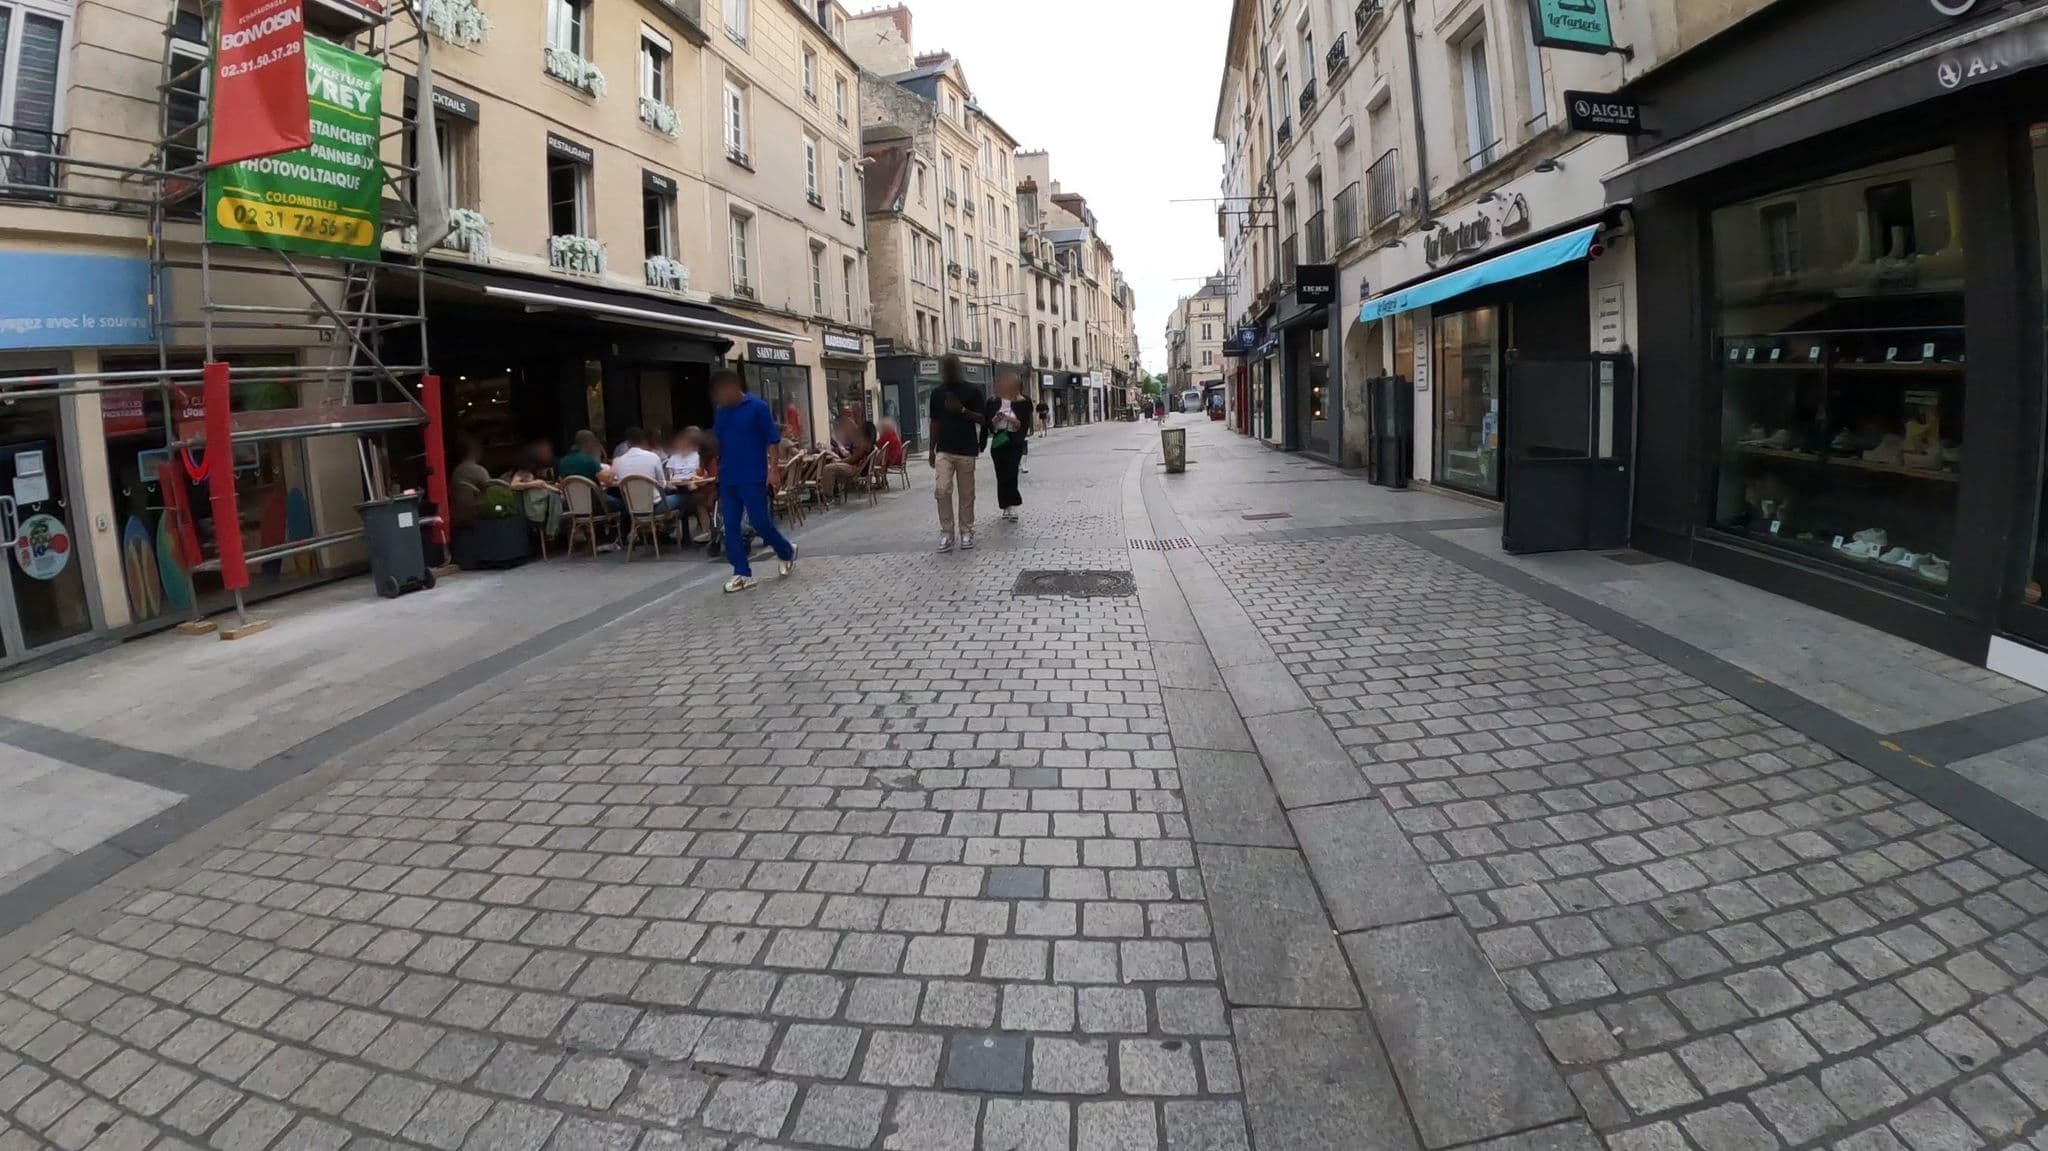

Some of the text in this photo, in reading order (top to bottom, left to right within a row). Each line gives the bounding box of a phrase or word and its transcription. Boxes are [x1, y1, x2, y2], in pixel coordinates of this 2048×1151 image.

[221, 6, 300, 51] BONVOISIN
[1560, 14, 1602, 33] Tarterie
[220, 41, 300, 78] 02.31.50.37.29
[310, 63, 372, 92] UVERTURE
[307, 72, 372, 113] VREY
[432, 92, 466, 113] CKTAILS
[1591, 103, 1635, 119] AIGLE
[310, 143, 374, 170] PANNEAUX
[548, 136, 592, 162] RESTAURANT
[239, 158, 361, 191] PHOTOVOLTAIQUE
[265, 191, 338, 210] COLOMBELLES
[234, 204, 258, 224] 02
[265, 210, 284, 229] 31
[294, 213, 315, 234] 72
[82, 313, 96, 328] le
